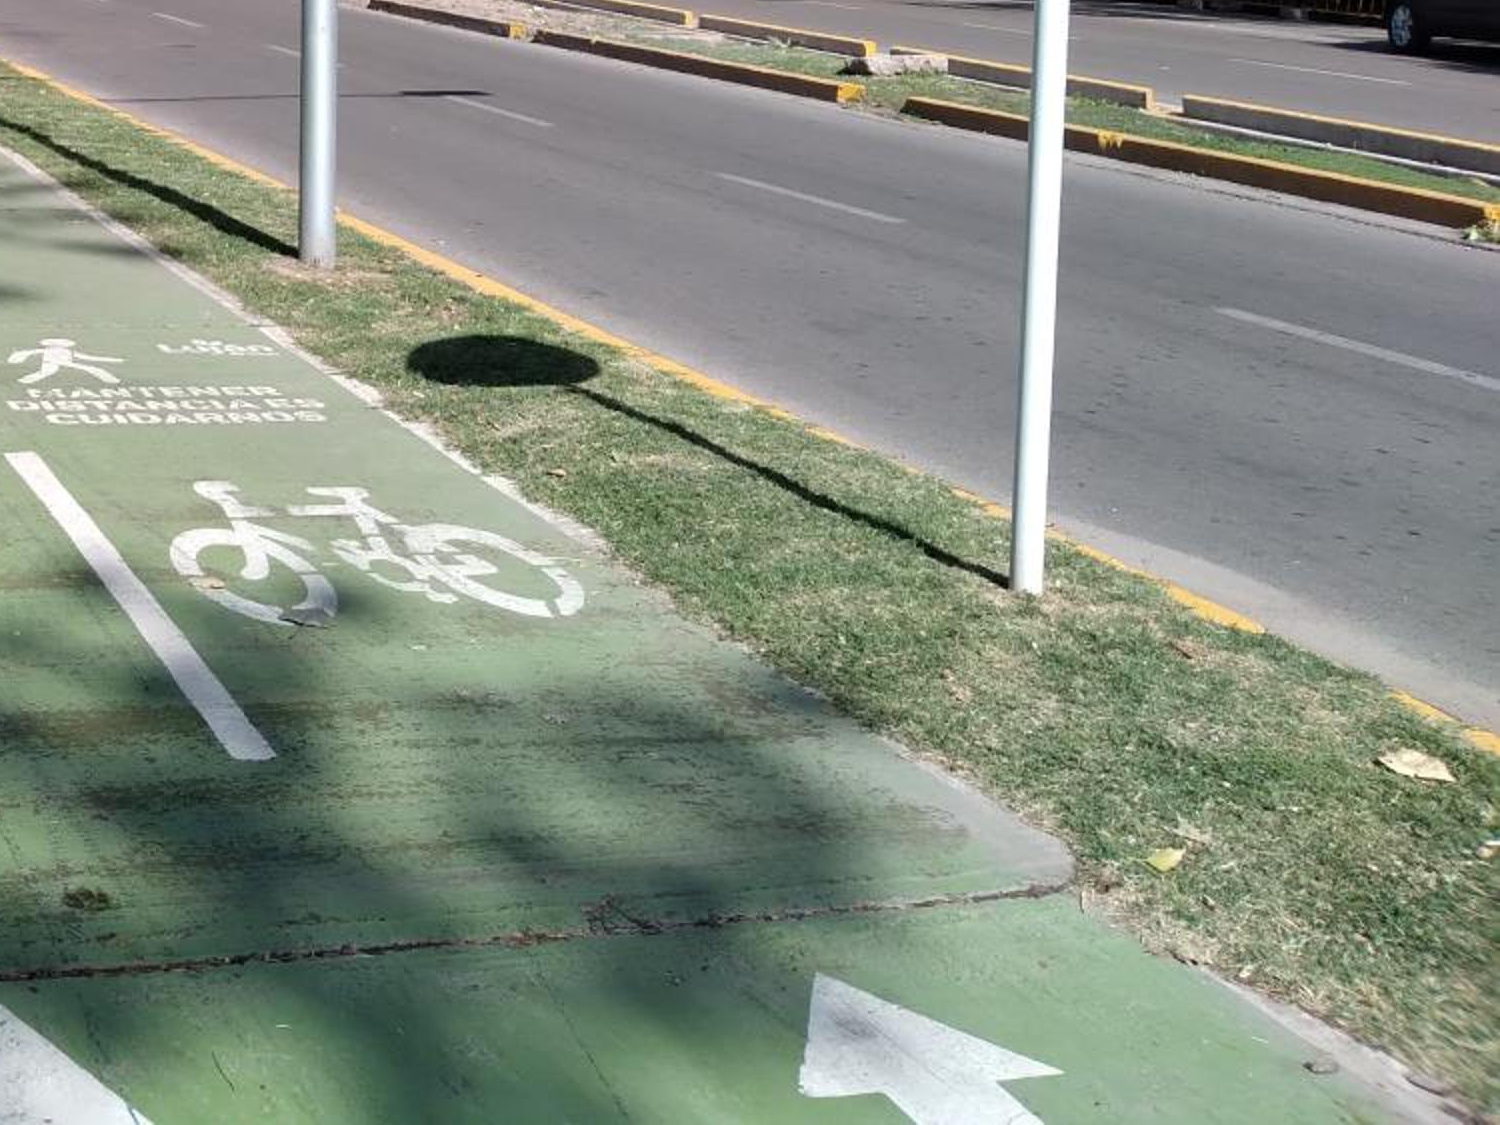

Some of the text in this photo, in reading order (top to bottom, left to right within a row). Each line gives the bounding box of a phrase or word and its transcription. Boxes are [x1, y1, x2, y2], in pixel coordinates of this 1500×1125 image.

[26, 386, 284, 398] MANTENER
[5, 397, 325, 412] DISTANCIA ES
[45, 410, 328, 424] CUIDARNOS
